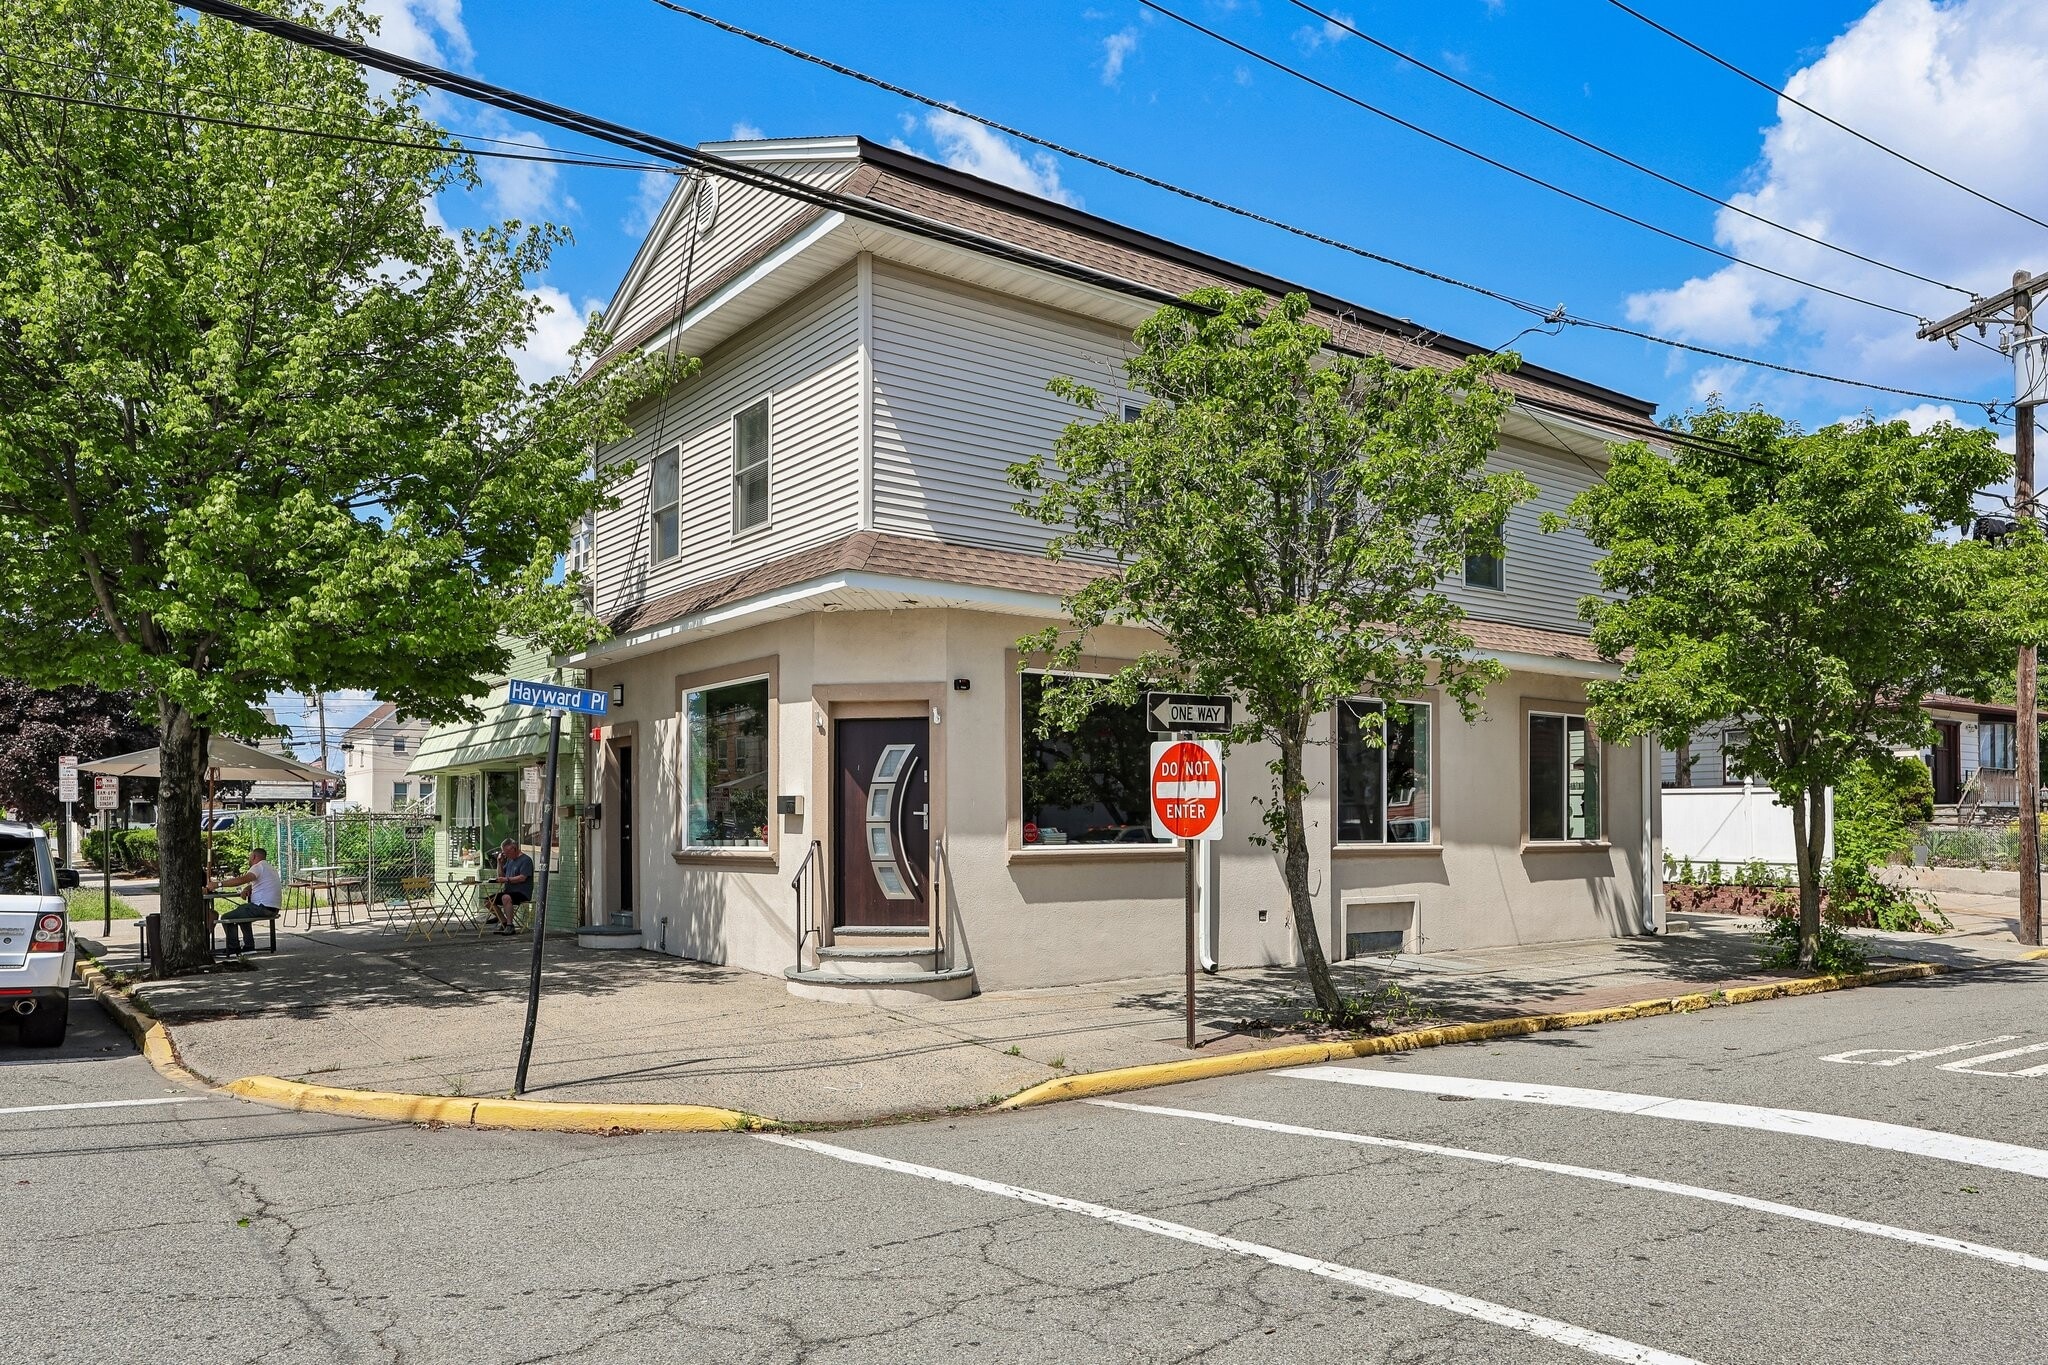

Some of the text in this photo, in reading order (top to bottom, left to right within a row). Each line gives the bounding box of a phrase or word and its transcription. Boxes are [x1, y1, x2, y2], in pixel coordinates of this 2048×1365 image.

[512, 681, 605, 710] Hayward Pl
[1171, 705, 1220, 722] ONE WAY
[1161, 761, 1210, 776] DO NOT
[1166, 804, 1206, 819] ENTER
